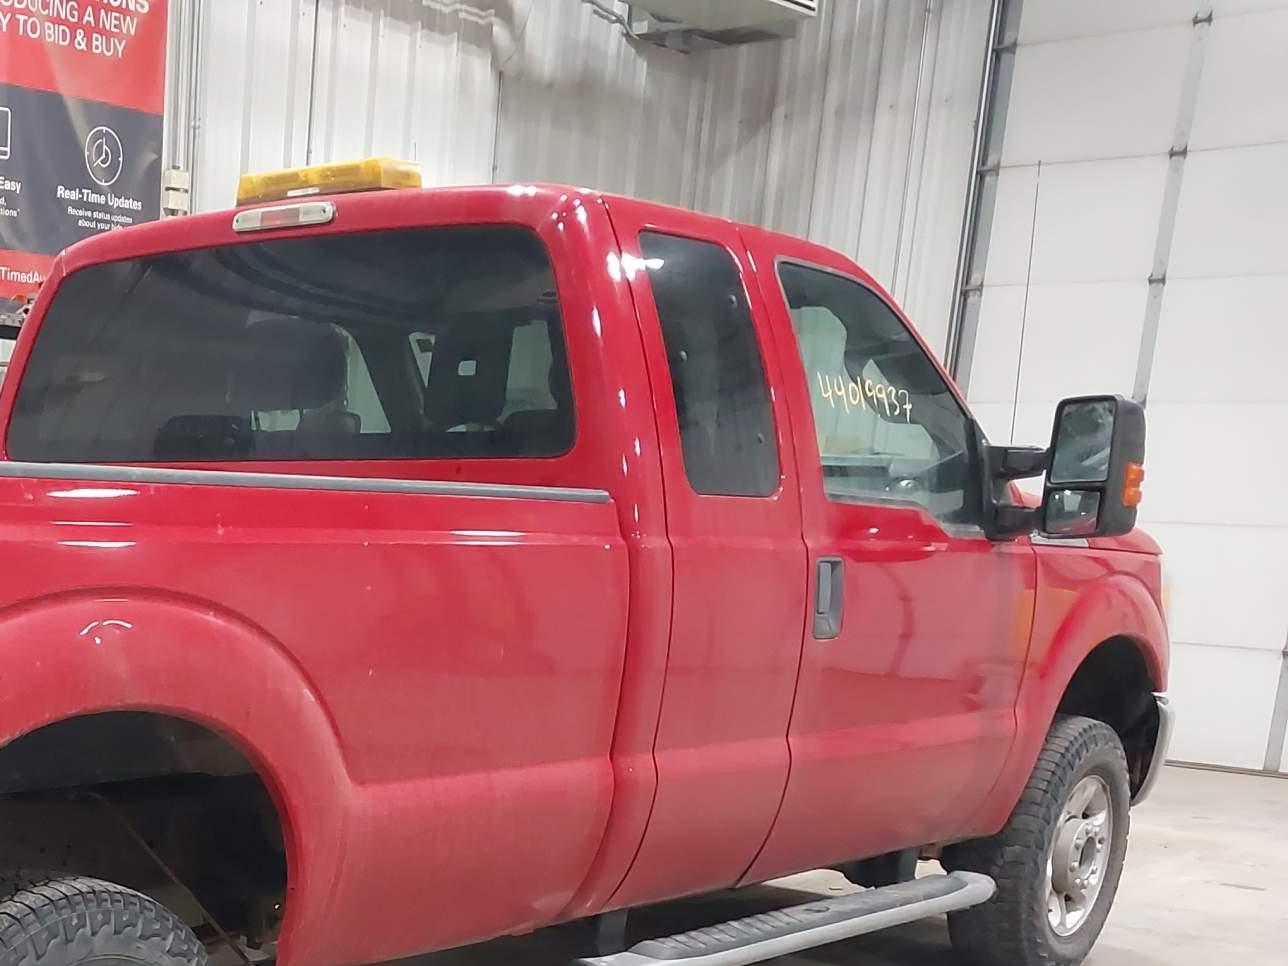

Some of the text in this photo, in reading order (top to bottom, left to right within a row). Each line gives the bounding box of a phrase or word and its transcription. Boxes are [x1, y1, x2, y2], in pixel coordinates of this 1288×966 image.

[83, 5, 95, 27] A
[99, 8, 138, 36] NEW
[15, 14, 41, 39] TO
[44, 22, 71, 46] BID
[74, 28, 88, 51] &
[92, 33, 126, 59] BUY
[56, 185, 142, 211] Real-Time Updates
[67, 205, 92, 218] Receive
[816, 371, 913, 425] 44019937
